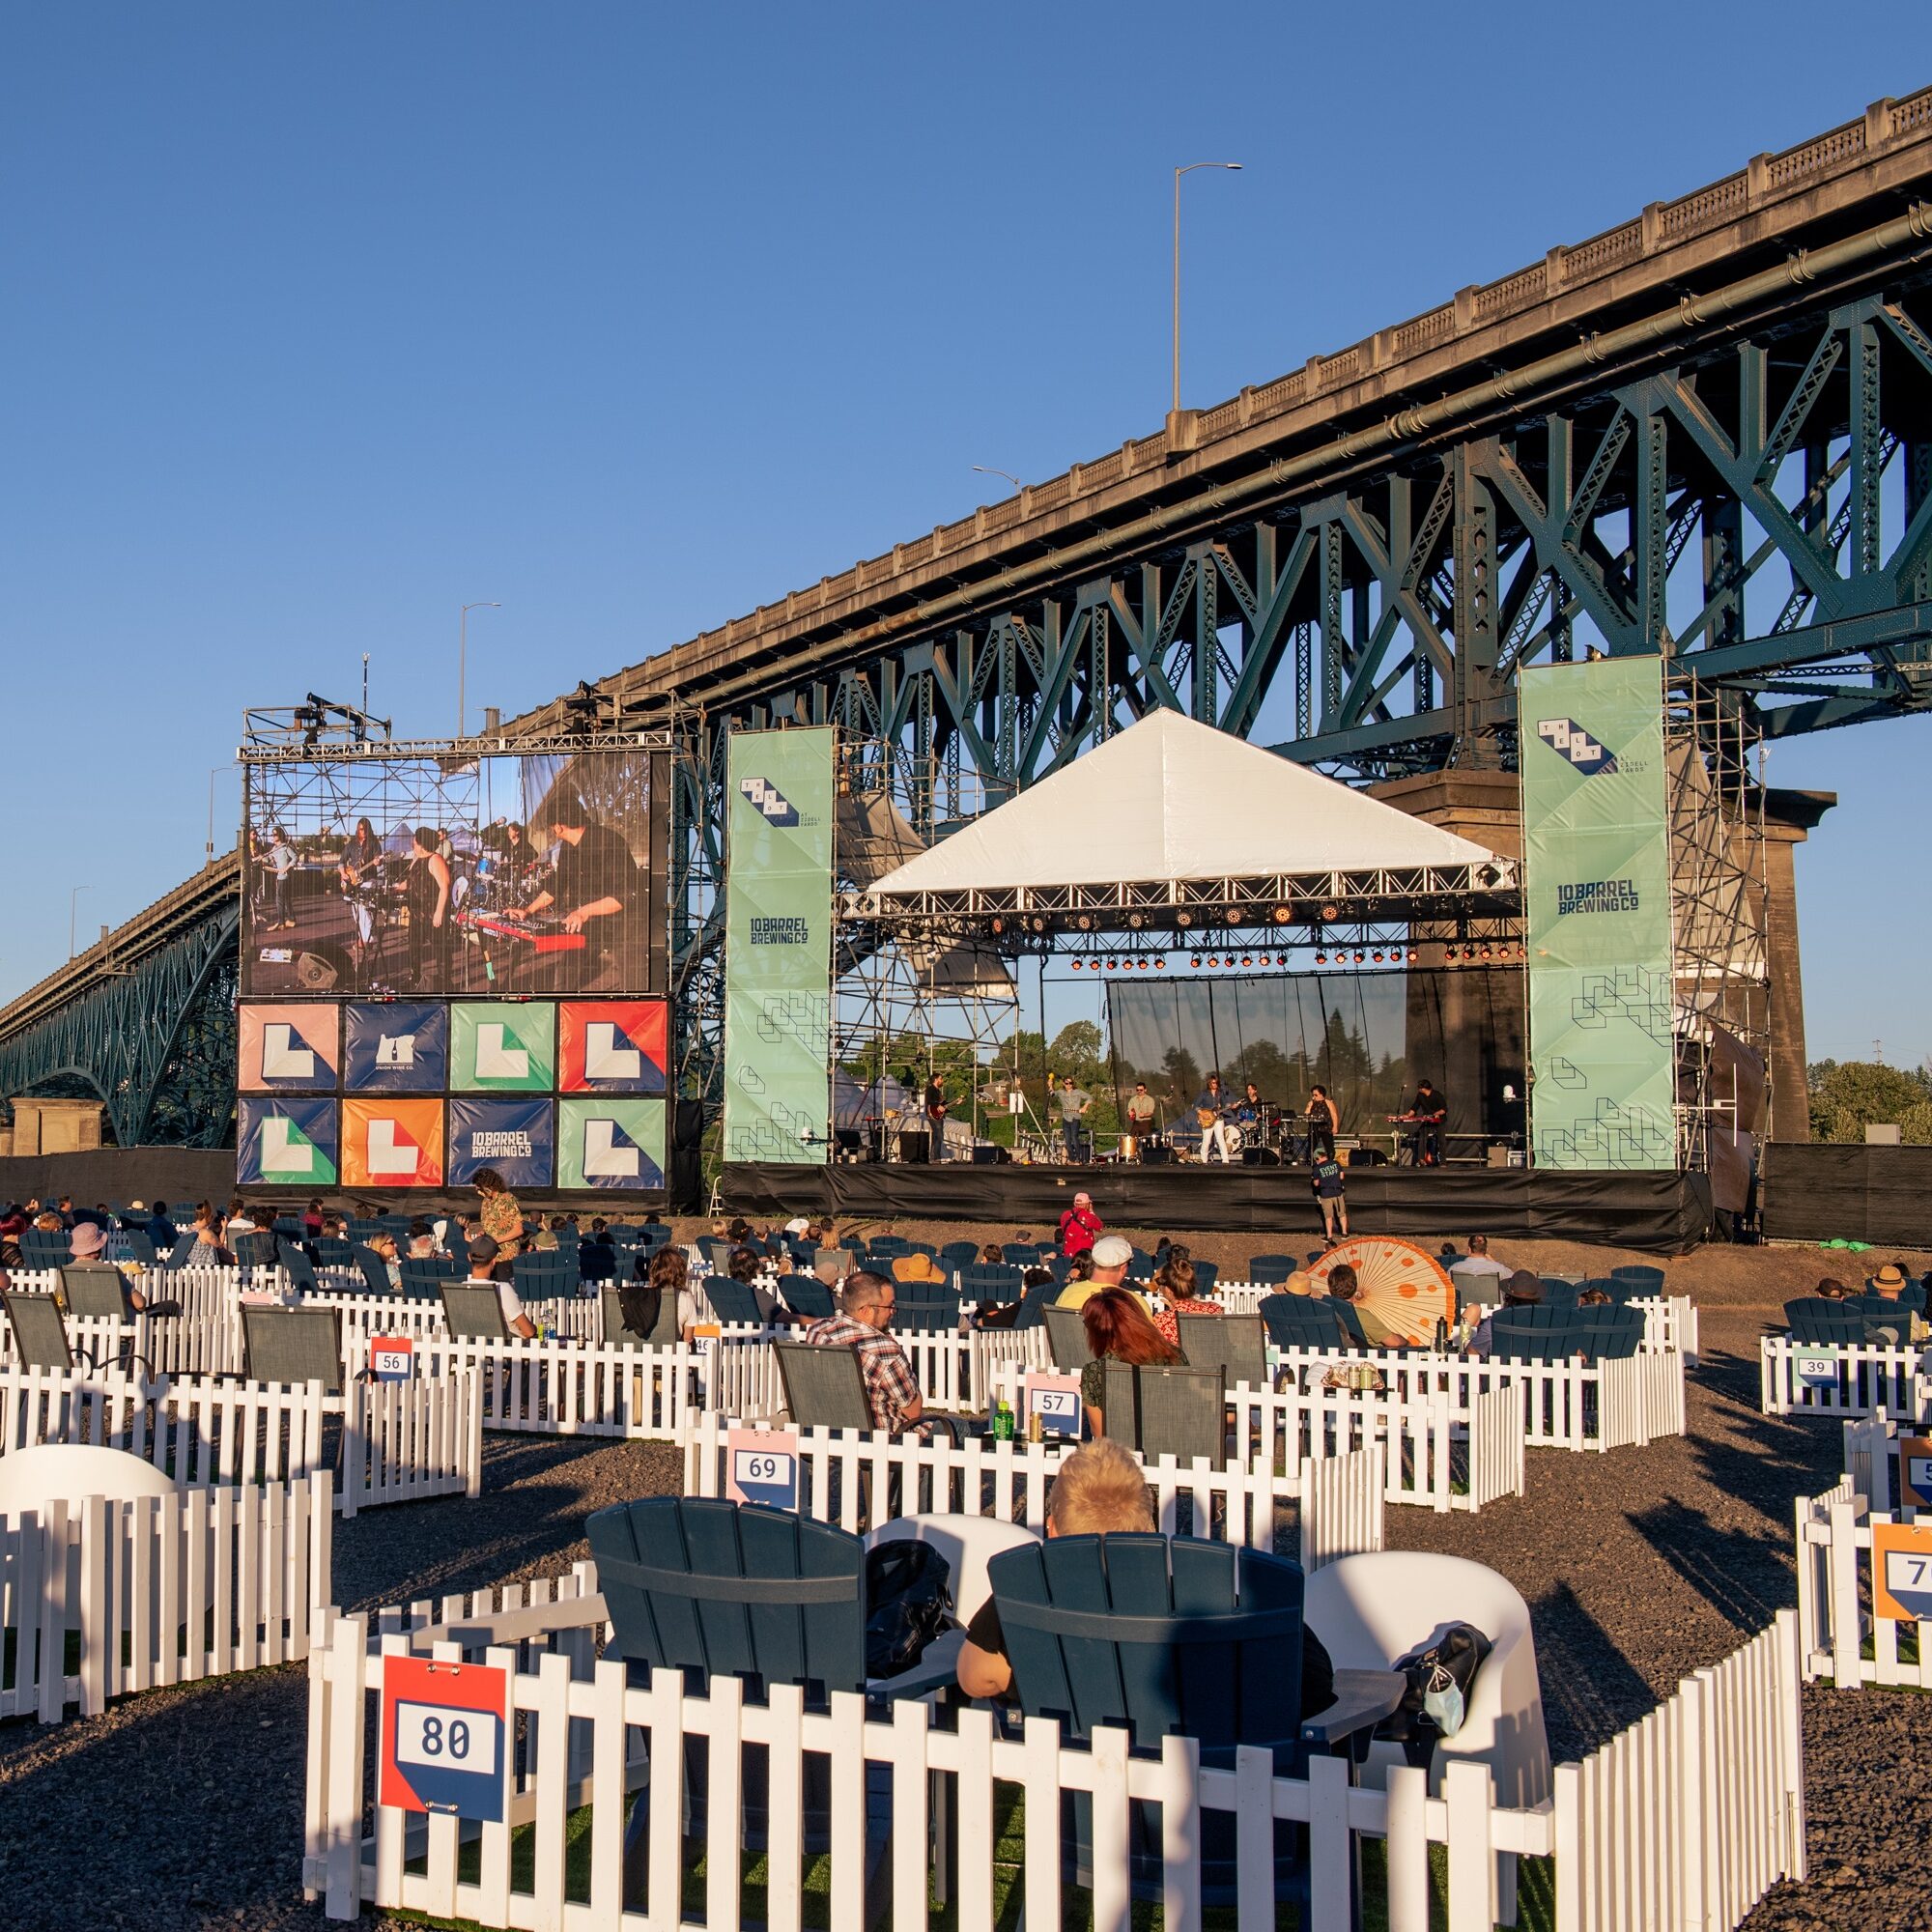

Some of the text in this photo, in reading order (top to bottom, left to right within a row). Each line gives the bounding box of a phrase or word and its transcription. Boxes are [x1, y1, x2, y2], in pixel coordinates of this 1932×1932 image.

[1320, 1163, 1338, 1173] EVENT
[1321, 1169, 1339, 1178] STAFF
[384, 1355, 400, 1369] 56
[1807, 1361, 1825, 1373] 39
[1043, 1395, 1064, 1410] 57
[750, 1458, 776, 1478] 69
[1908, 1560, 1932, 1585] 7
[422, 1716, 469, 1759] 80
